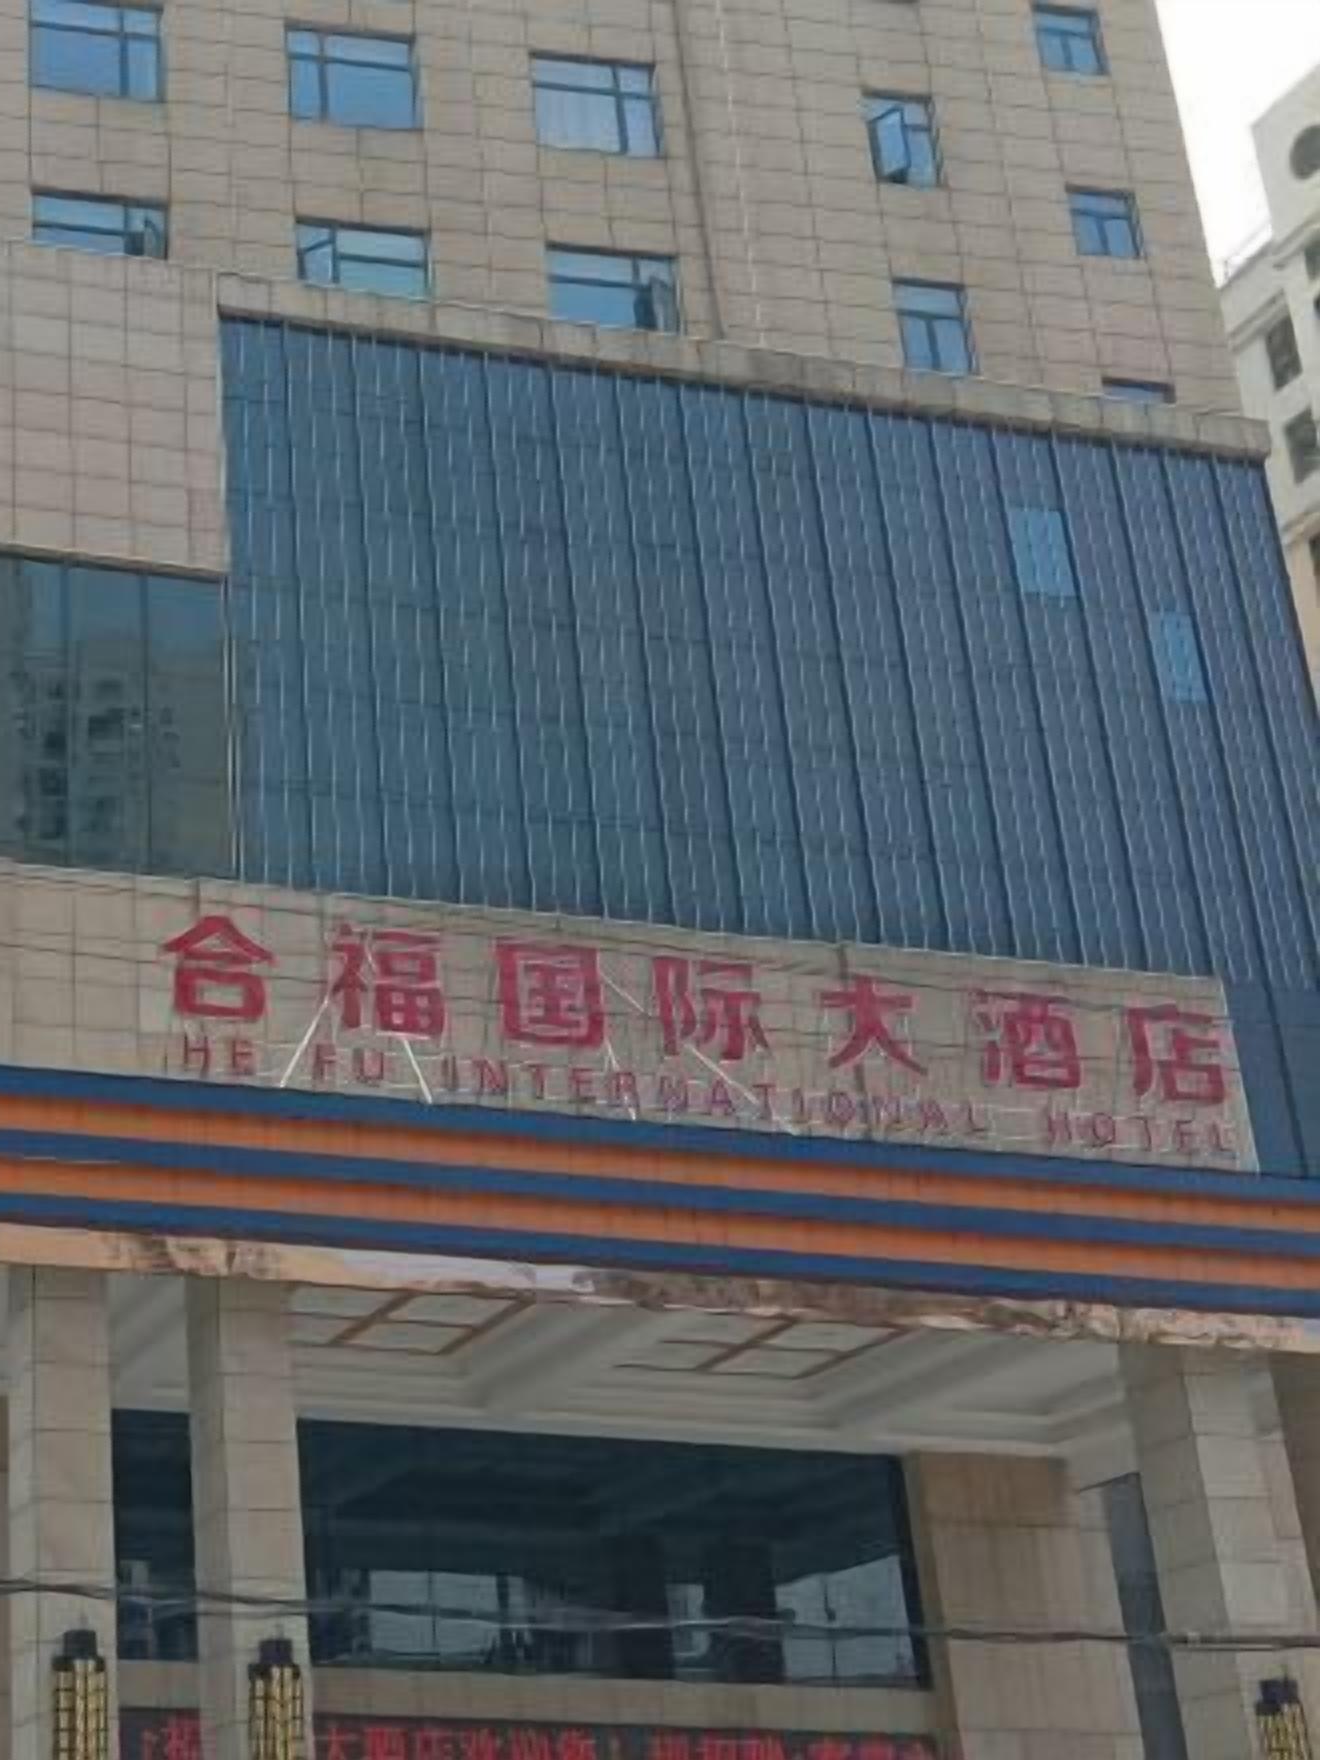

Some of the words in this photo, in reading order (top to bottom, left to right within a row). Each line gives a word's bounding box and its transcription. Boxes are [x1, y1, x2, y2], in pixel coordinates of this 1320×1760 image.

[162, 914, 1228, 1106] 合福国际大酒店
[182, 1034, 257, 1077] HE
[312, 1042, 386, 1085] FU
[440, 1053, 985, 1134] INTERNATIONAL
[1044, 1106, 1234, 1153] HOTEL
